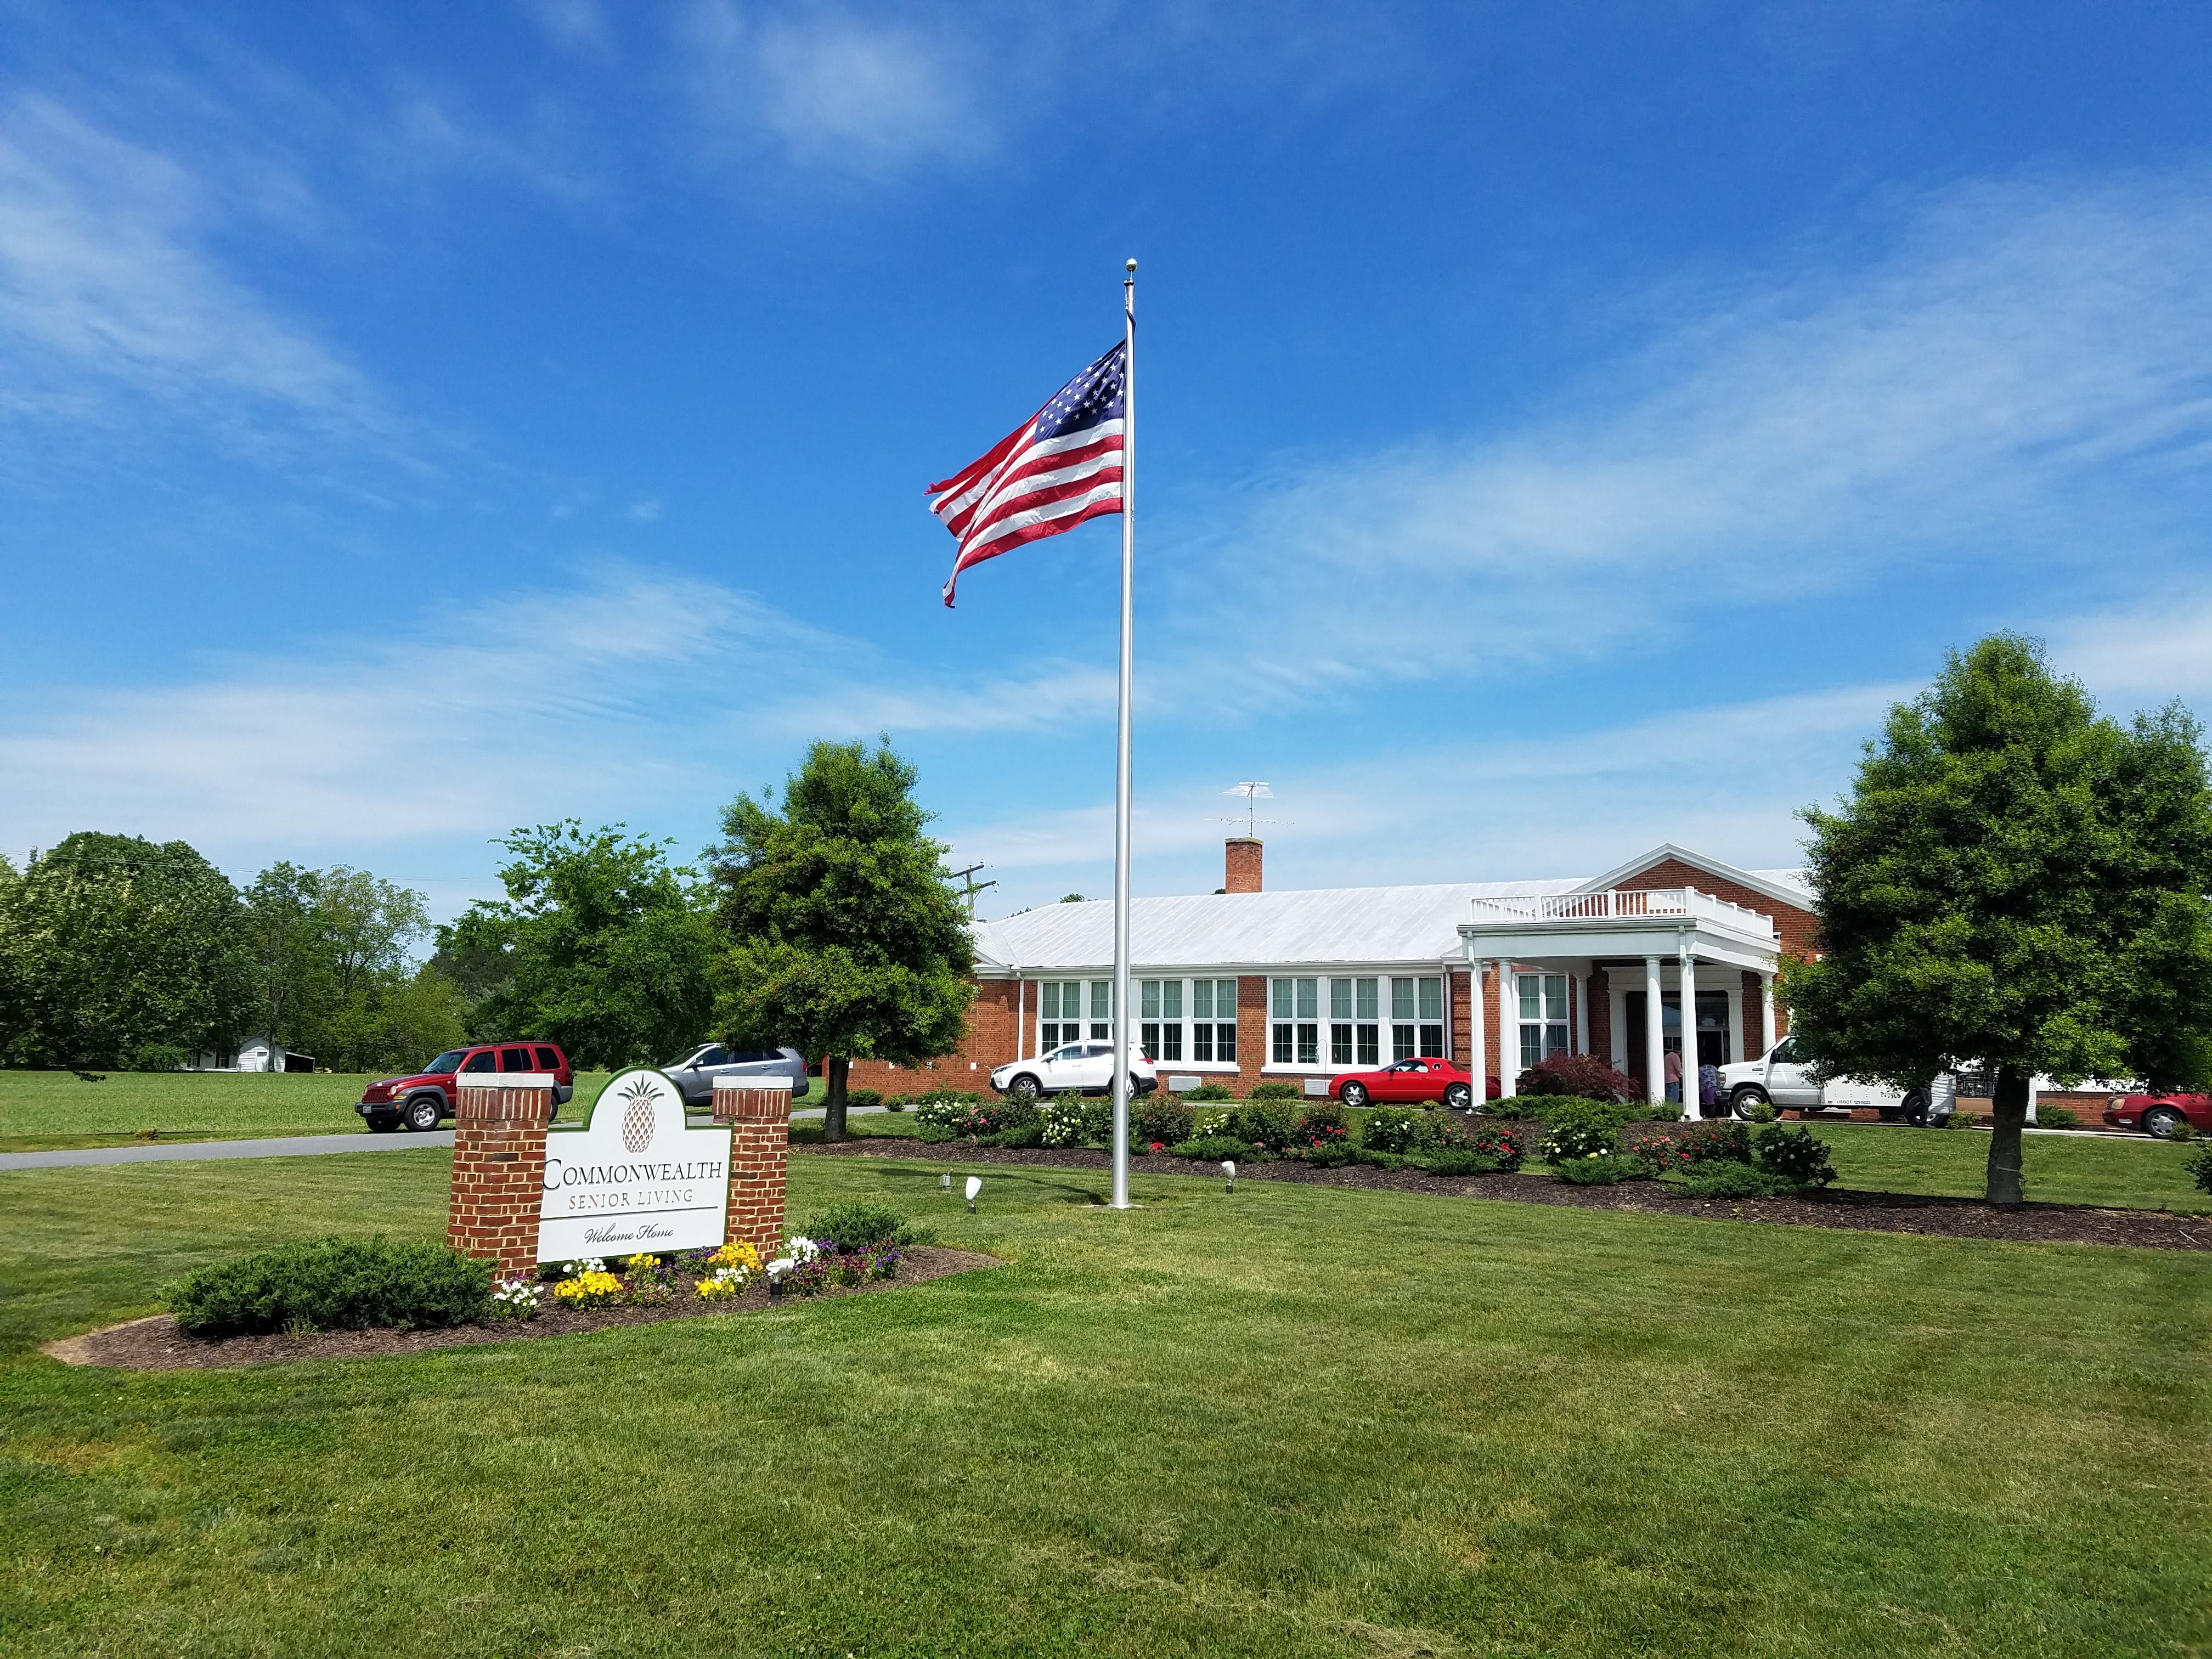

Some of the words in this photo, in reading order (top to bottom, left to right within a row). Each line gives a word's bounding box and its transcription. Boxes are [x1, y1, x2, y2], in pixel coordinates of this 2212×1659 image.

[569, 1193, 630, 1210] SENIOR
[637, 1189, 692, 1205] LIVING
[584, 1222, 634, 1244] Welcome
[636, 1223, 674, 1239] Home
